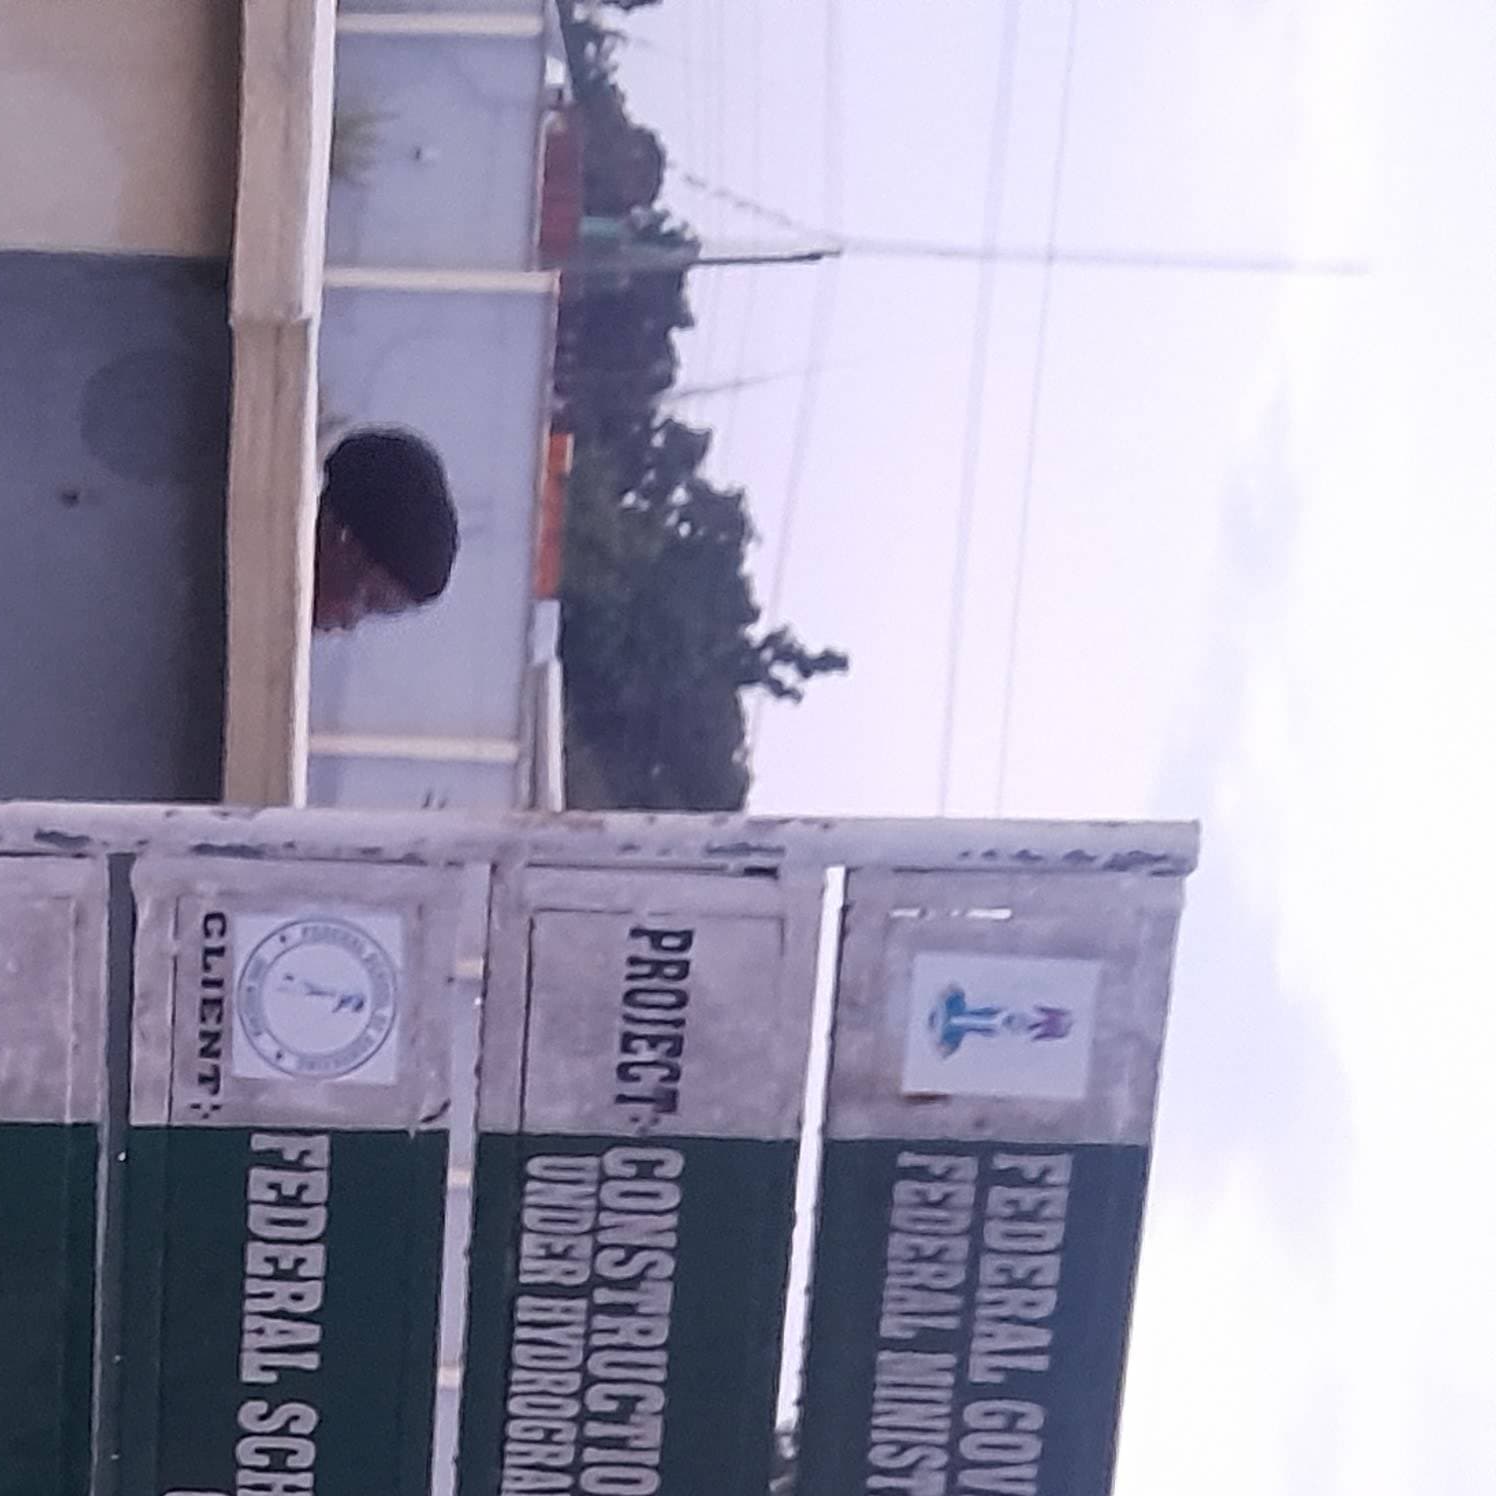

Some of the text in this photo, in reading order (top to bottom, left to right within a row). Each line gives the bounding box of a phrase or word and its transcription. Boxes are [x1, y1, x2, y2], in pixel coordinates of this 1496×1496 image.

[239, 1133, 331, 1383] FEDERAL
[519, 1155, 594, 1285] UNDER
[879, 1150, 977, 1340] FEDERAL
[966, 1150, 1074, 1384] FEDERAL
